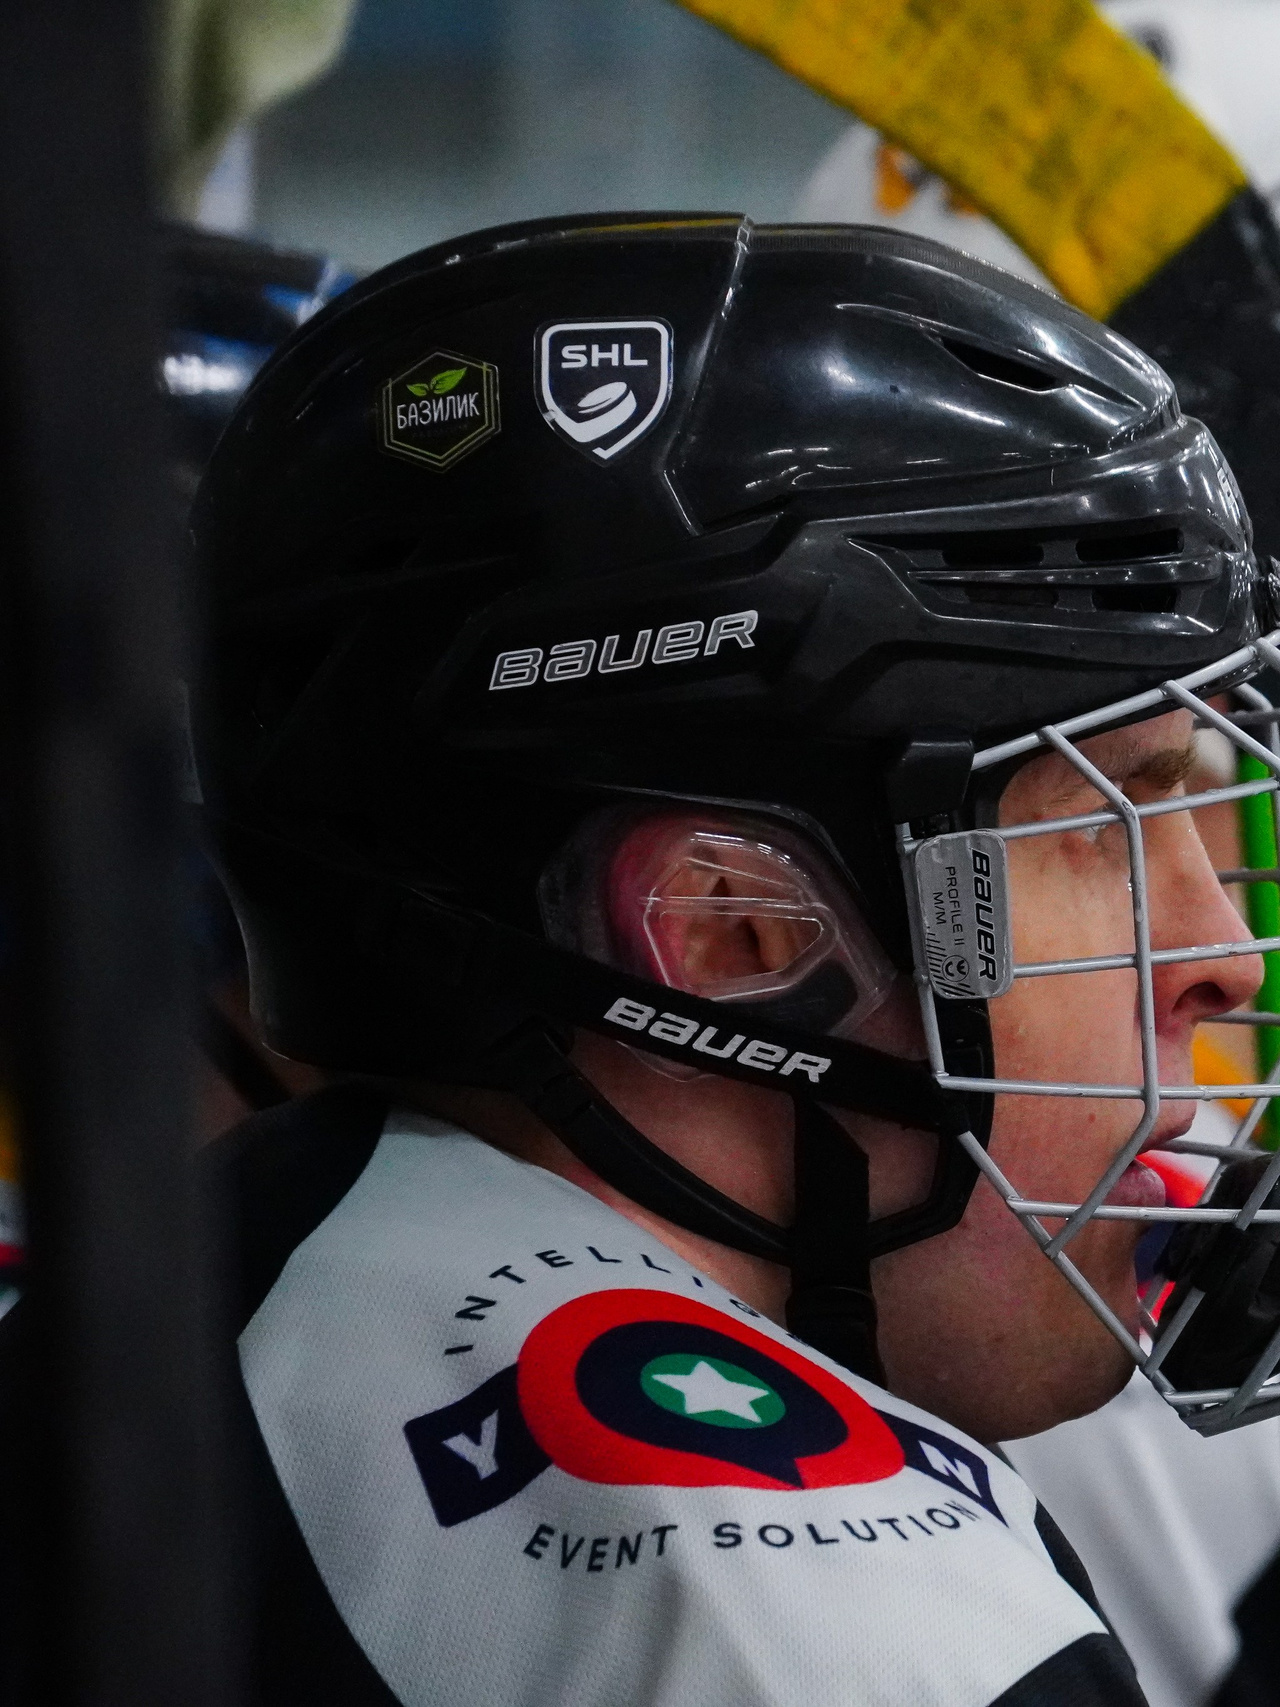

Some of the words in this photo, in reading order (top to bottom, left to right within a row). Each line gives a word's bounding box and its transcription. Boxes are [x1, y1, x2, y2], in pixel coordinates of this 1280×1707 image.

[561, 343, 649, 368] SHL
[396, 391, 480, 430] БАЗИЛИК
[489, 609, 759, 691] BAUER
[932, 890, 947, 925] M/M
[945, 866, 963, 934] PROFILE
[971, 848, 998, 982] BAUER
[603, 997, 832, 1084] BAUER
[523, 1523, 678, 1574] EVENT
